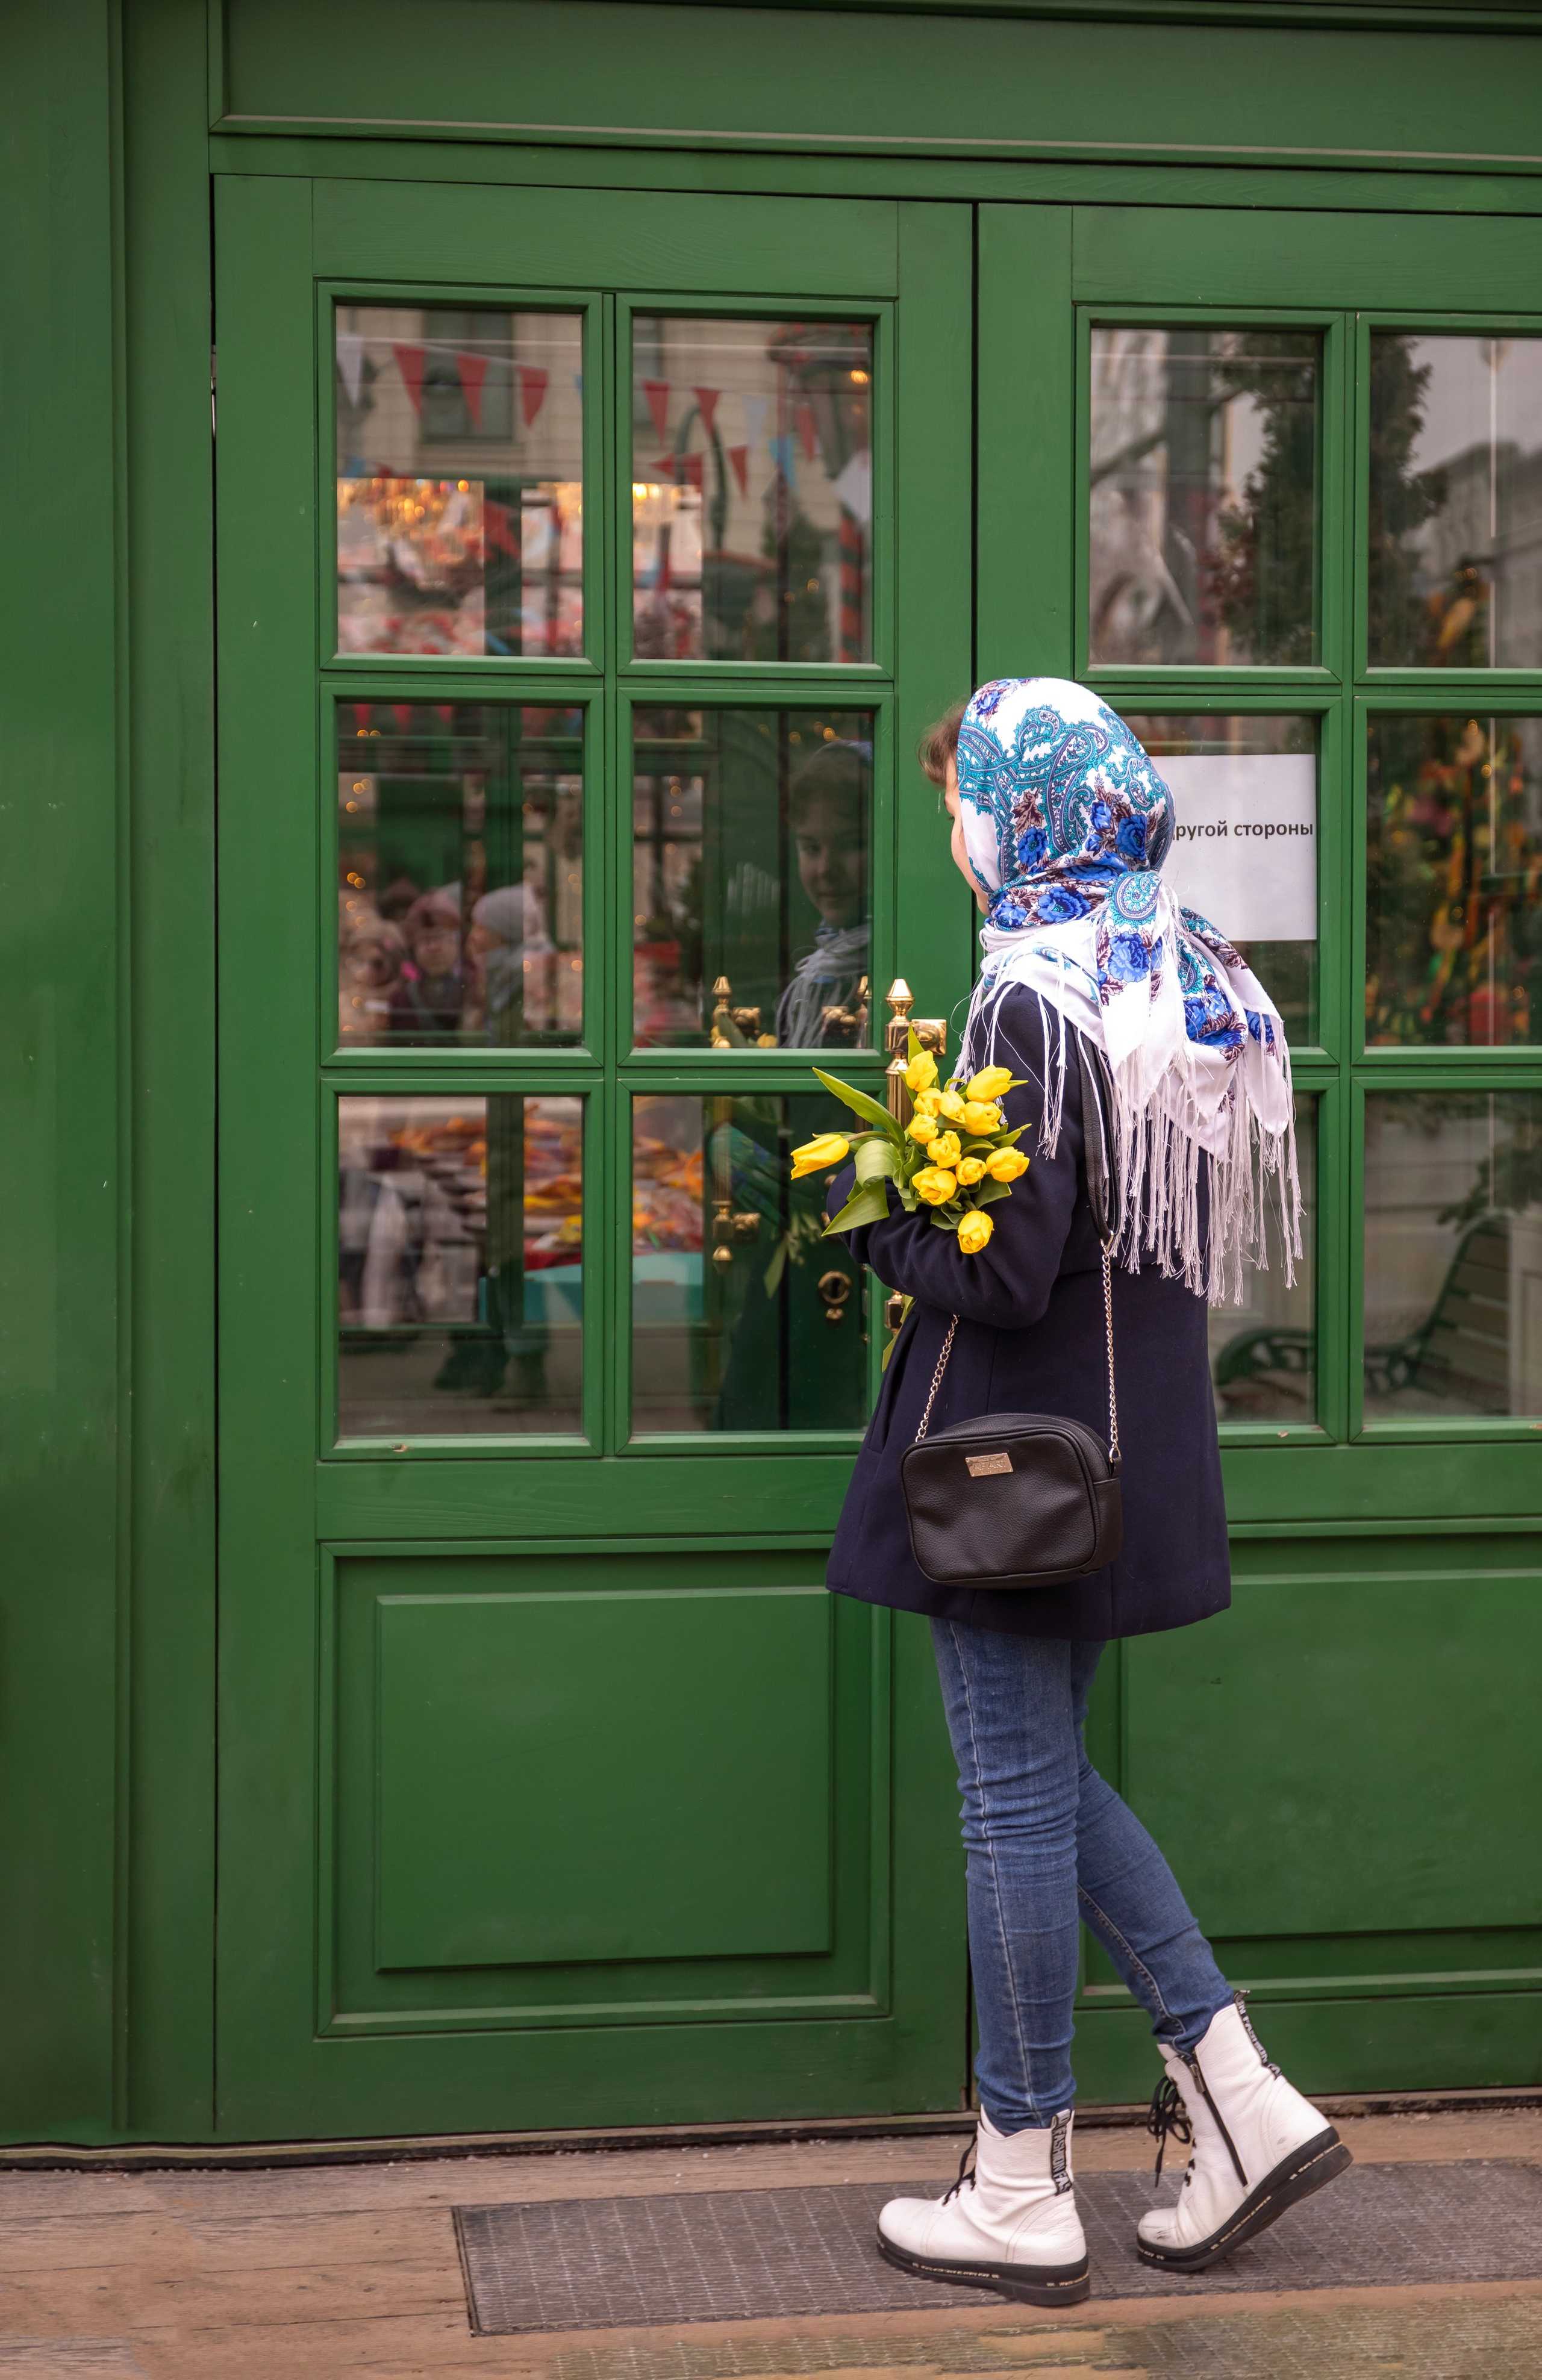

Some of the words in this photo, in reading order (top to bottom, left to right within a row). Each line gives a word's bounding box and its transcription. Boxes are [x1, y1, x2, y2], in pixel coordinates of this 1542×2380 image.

[1173, 820, 1228, 840] ругой
[1234, 823, 1313, 839] стороны
[1053, 2128, 1066, 2173] FASHION
